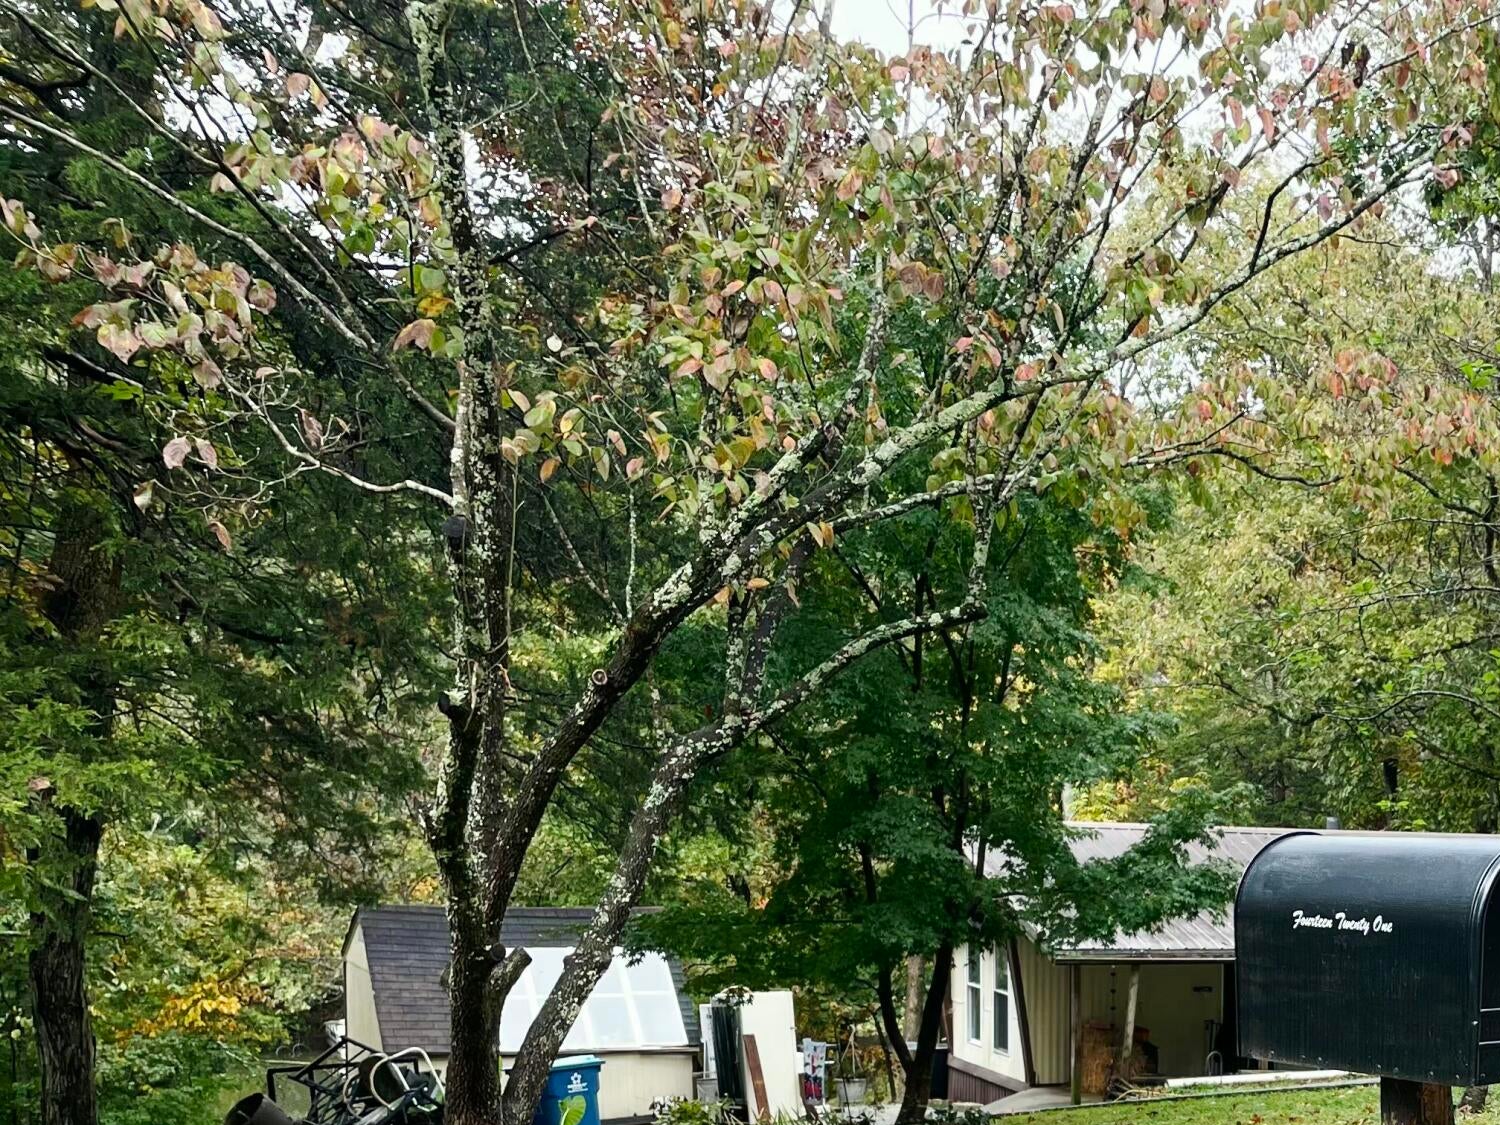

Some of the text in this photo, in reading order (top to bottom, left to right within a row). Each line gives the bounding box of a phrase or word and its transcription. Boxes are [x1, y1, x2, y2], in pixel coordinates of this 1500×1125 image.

[1292, 910, 1393, 936] Fourteen Twenty One
